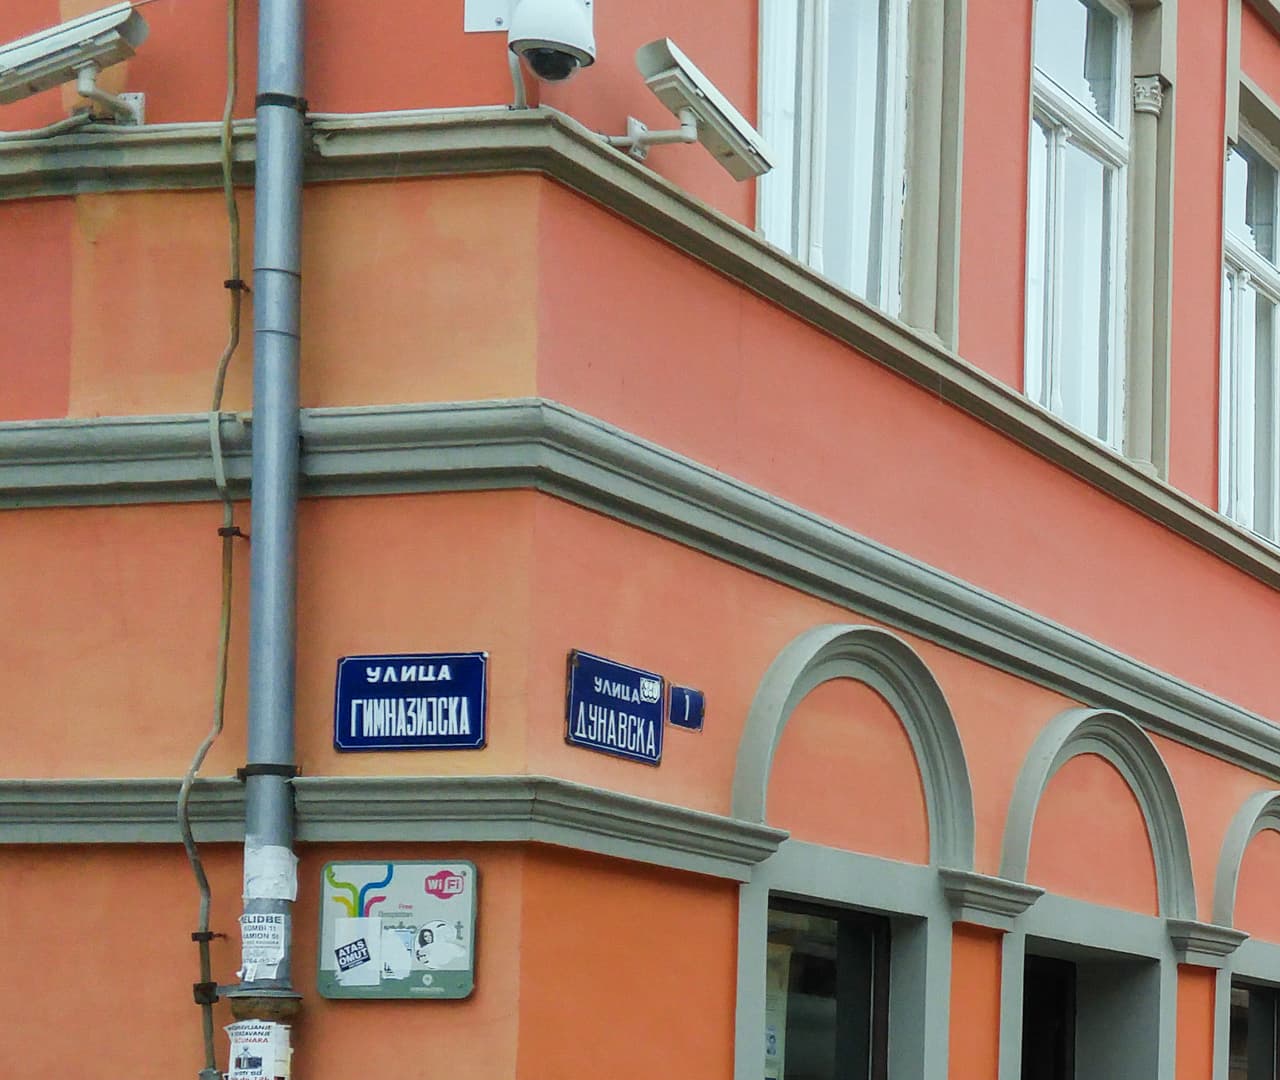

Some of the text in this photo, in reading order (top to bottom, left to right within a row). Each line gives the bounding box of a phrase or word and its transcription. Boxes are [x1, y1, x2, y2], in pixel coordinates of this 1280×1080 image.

[366, 664, 452, 683] УЛИЦА
[594, 676, 642, 705] УЛИЦА
[350, 696, 471, 738] ГИМНАЗИЈСКА
[684, 694, 690, 721] 1
[574, 701, 656, 757] ДУНАВСКА
[338, 940, 365, 957] ATAS
[339, 948, 367, 965] OMUT
